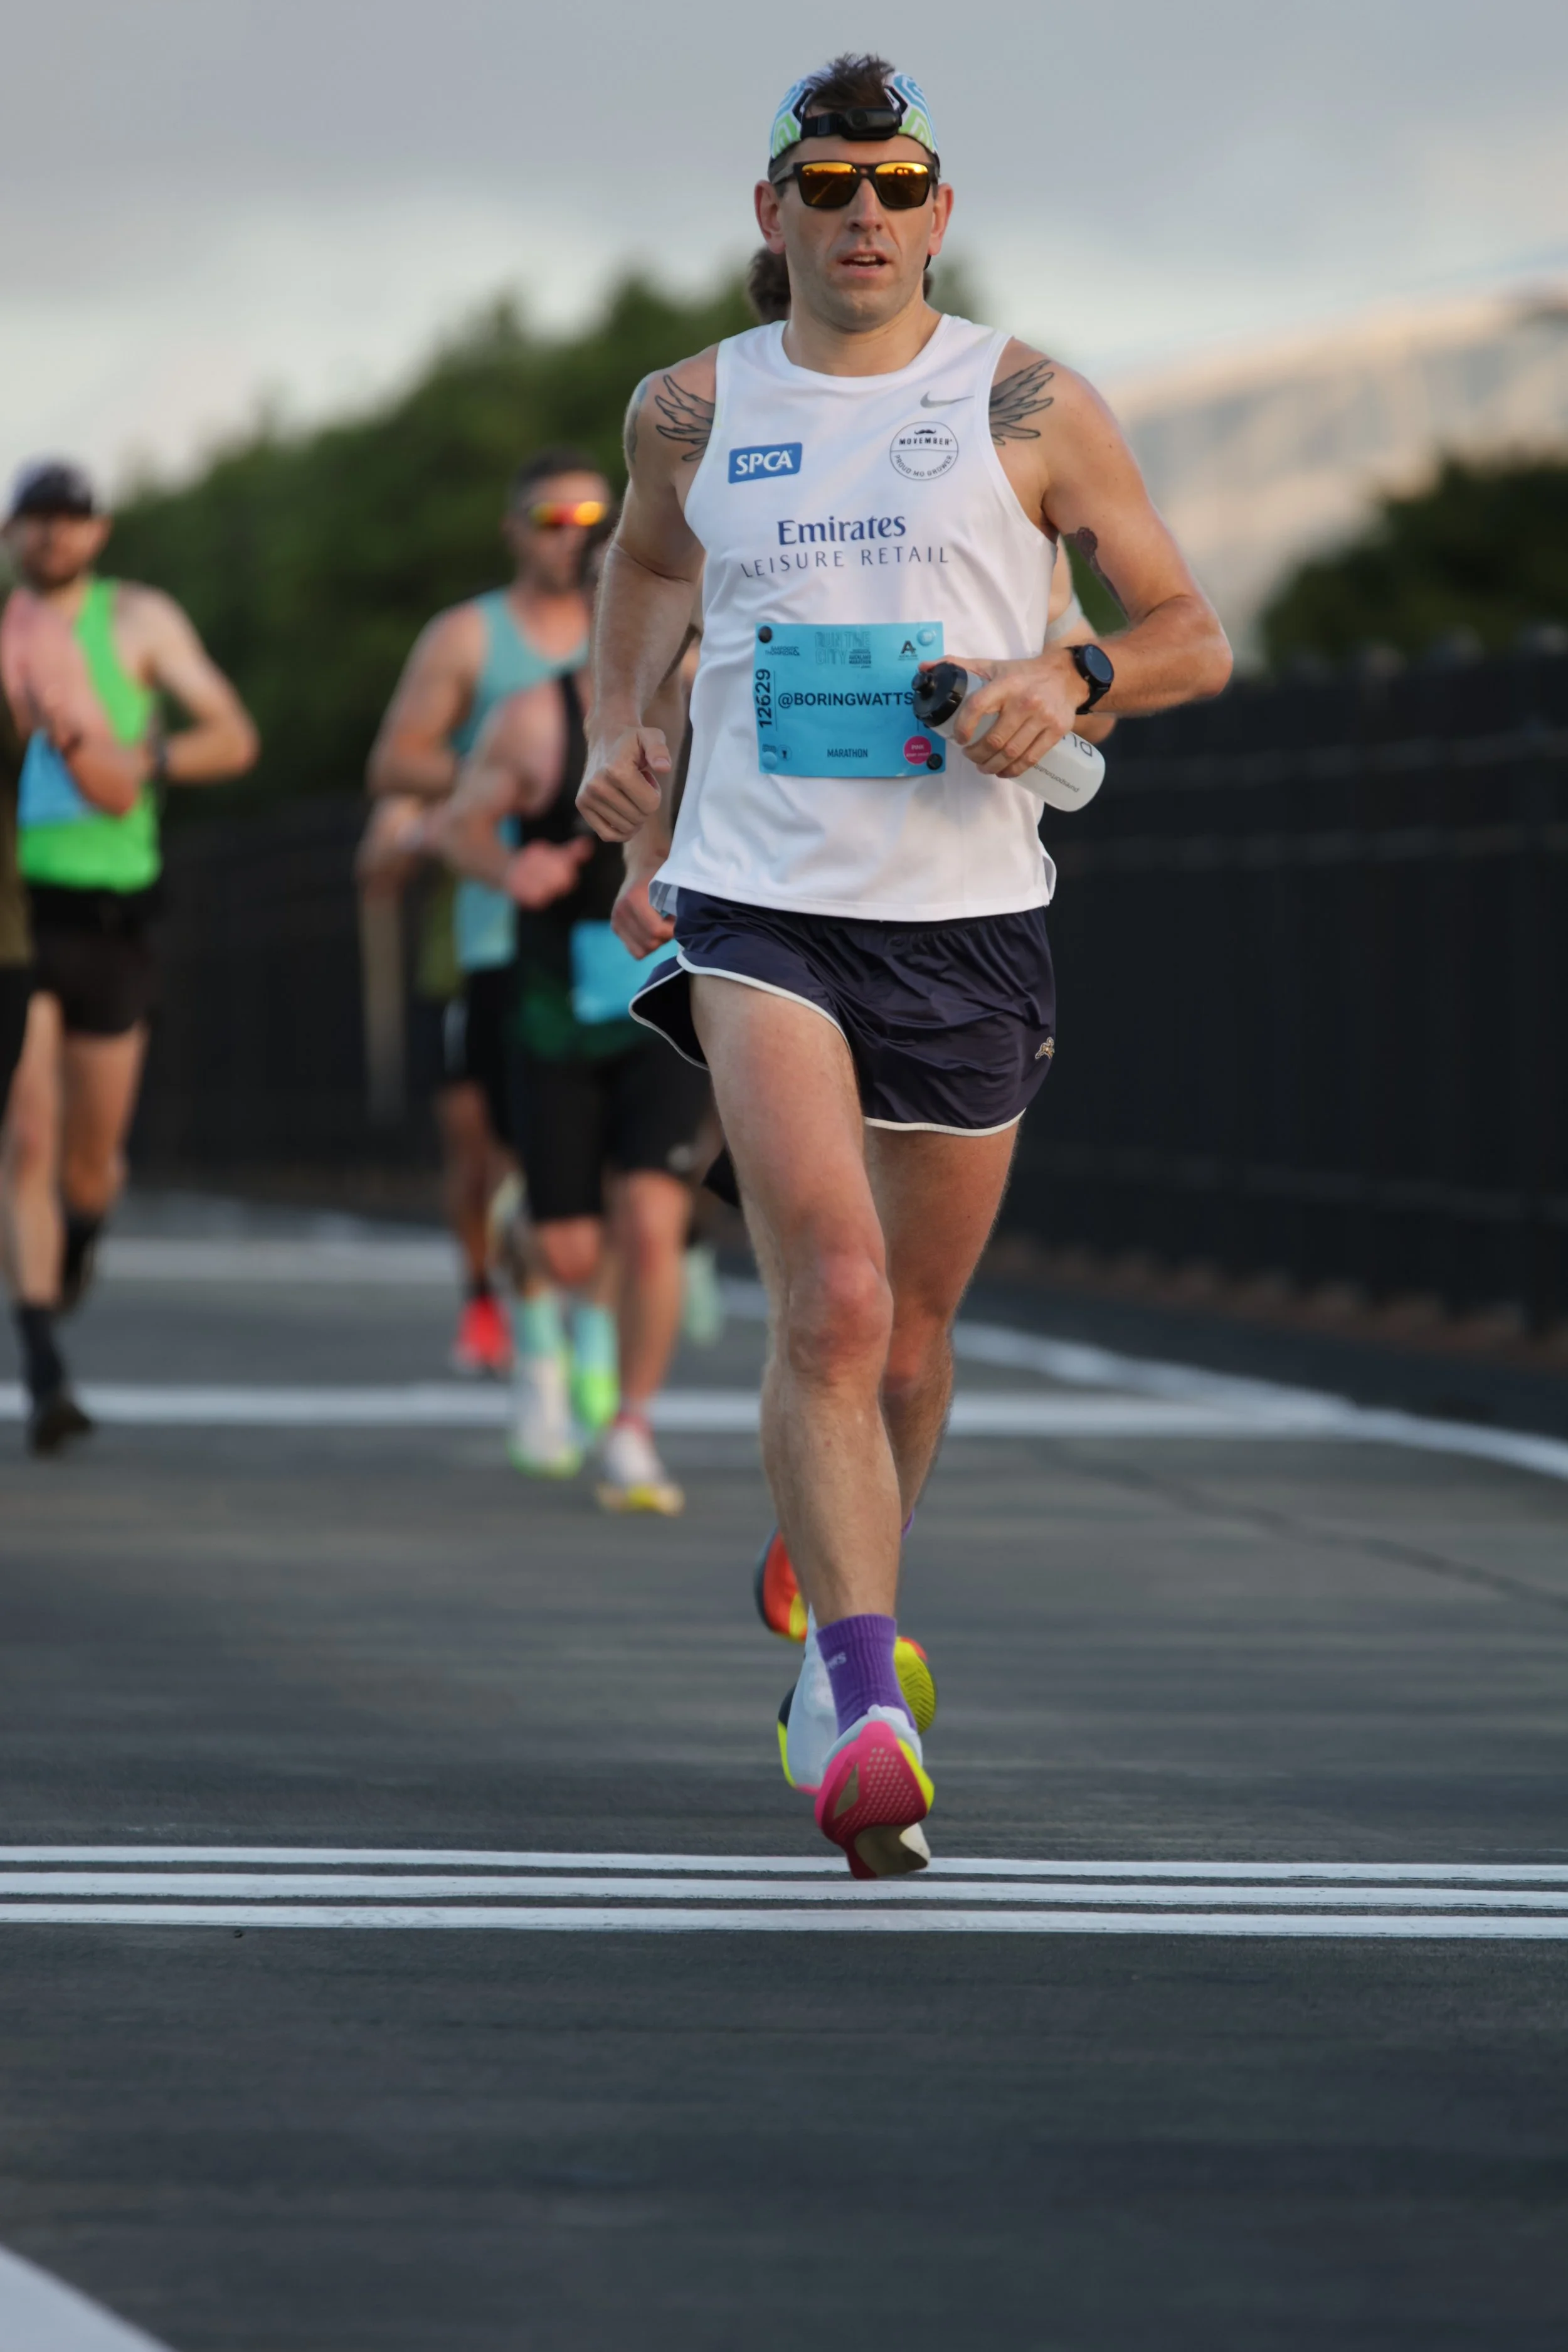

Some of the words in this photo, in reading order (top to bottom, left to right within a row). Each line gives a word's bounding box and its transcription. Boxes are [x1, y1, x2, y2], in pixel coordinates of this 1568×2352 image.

[899, 437, 950, 445] MOVEMBER
[735, 450, 793, 475] SPCA
[894, 454, 912, 474] PROUD
[927, 455, 953, 476] GROWER
[777, 515, 906, 546] Emirates
[740, 550, 845, 578] LEISURE
[861, 546, 948, 566] RETAIL
[815, 648, 847, 665] CITY
[755, 669, 772, 728] 12629
[778, 692, 914, 709] @BORINGWATTS
[827, 748, 869, 758] MARATHON
